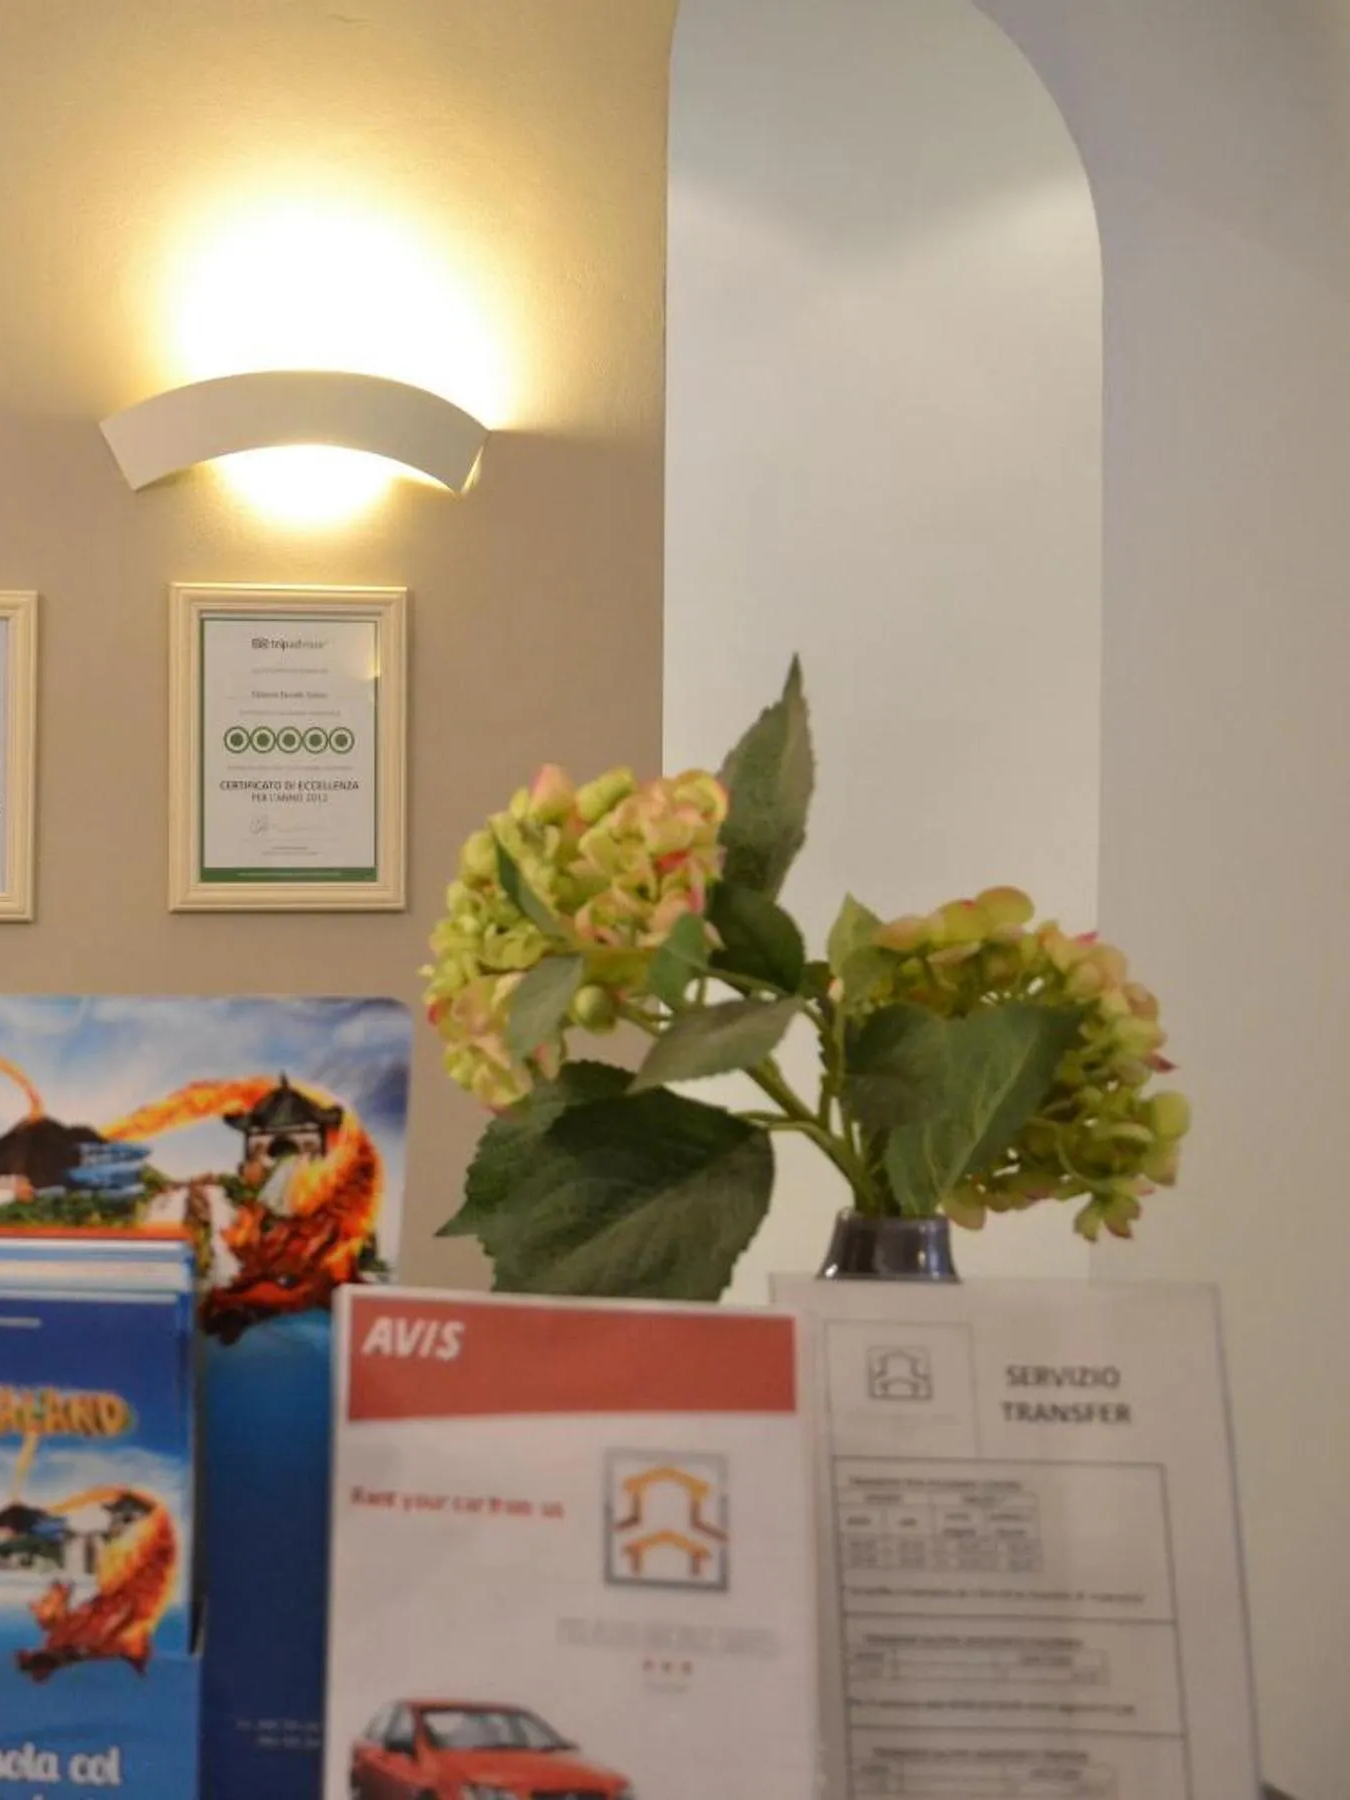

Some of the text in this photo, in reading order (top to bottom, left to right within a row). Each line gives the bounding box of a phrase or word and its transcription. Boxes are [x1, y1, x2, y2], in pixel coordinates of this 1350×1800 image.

[219, 780, 359, 791] CERTIFICATO DI ECCELLENZA
[251, 792, 268, 802] PER
[306, 793, 328, 802] 2012
[361, 1316, 466, 1361] AVIS
[1005, 1365, 1121, 1390] SERVIZIO
[1001, 1401, 1132, 1425] TRANSFER
[68, 1745, 122, 1786] col
